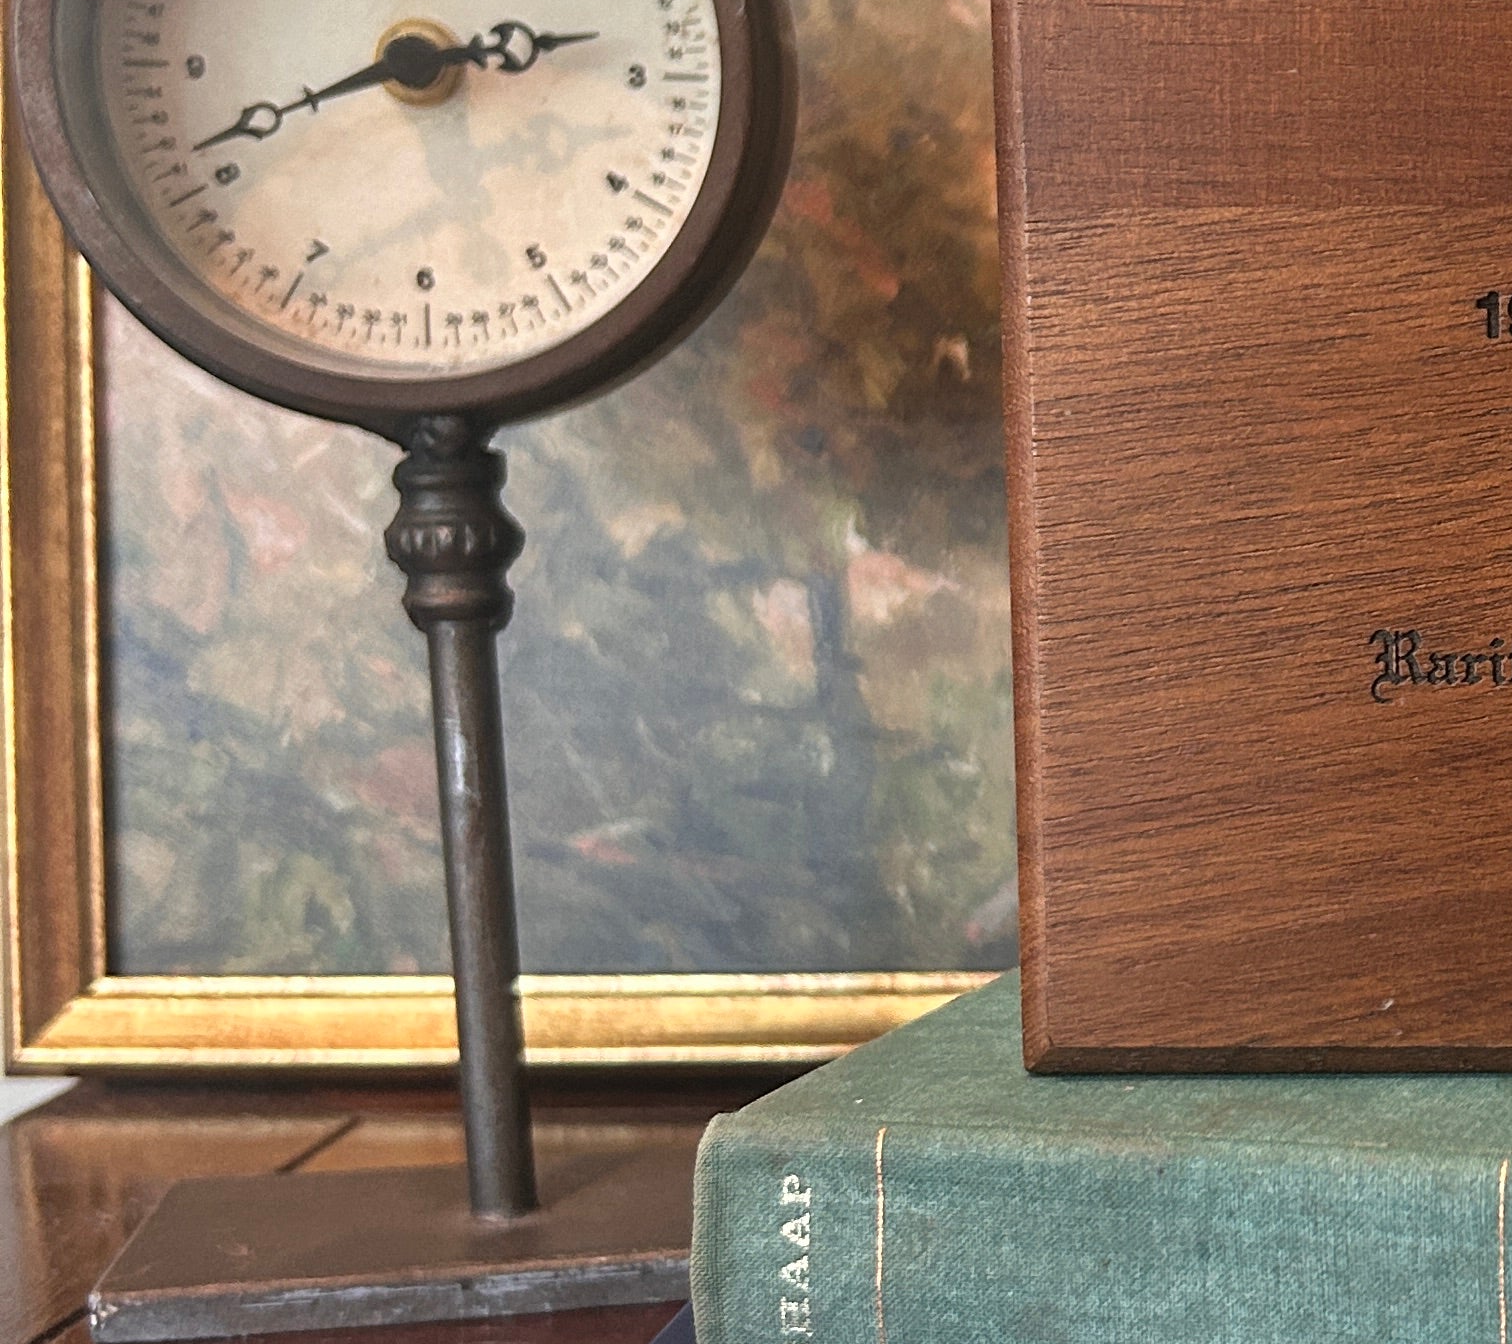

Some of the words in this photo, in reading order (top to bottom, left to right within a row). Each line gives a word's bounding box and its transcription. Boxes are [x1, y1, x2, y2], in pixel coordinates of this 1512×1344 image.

[627, 63, 648, 90] 3
[606, 170, 630, 194] 4
[306, 238, 330, 263] 7
[525, 243, 548, 269] 5
[416, 264, 436, 291] 6
